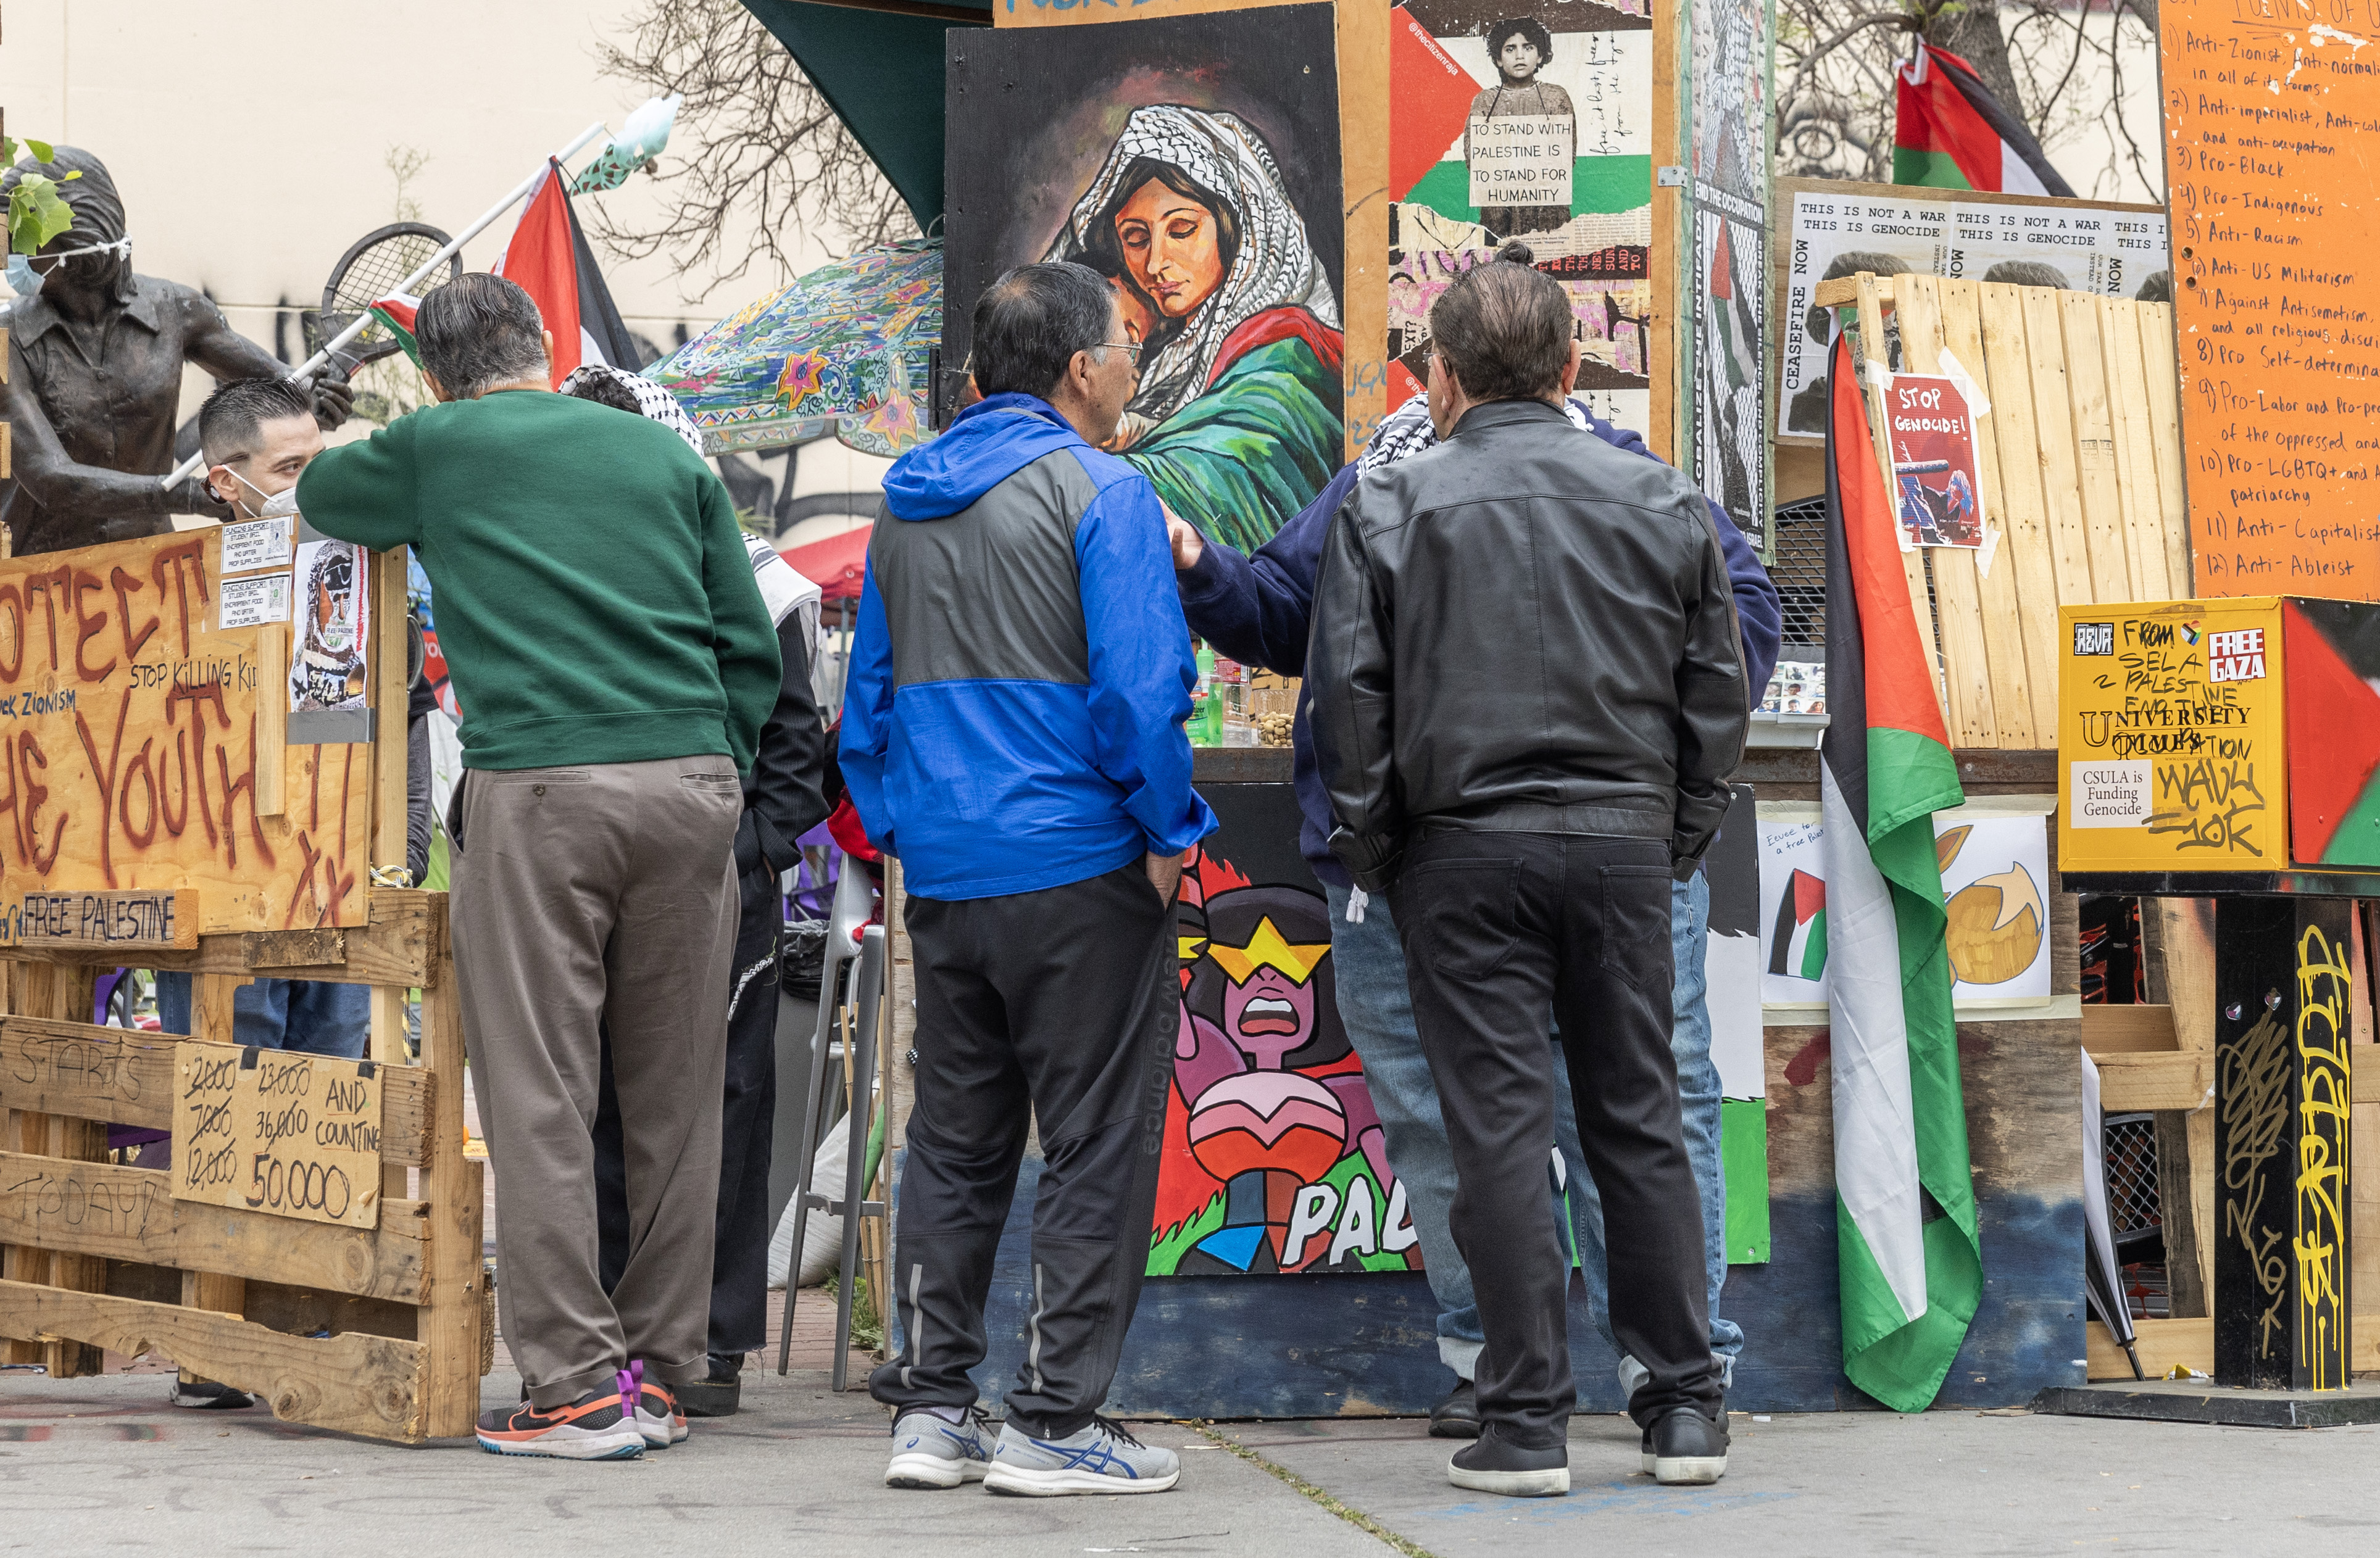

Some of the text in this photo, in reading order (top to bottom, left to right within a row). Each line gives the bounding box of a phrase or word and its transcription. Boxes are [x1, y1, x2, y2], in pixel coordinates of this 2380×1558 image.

[1408, 22, 1458, 76] @thecitizenraja
[2193, 68, 2208, 80] in
[2218, 69, 2236, 85] all
[2244, 72, 2258, 85] of
[2171, 88, 2188, 114] 2)
[1472, 123, 1571, 135] TO STAND WITH
[2203, 130, 2227, 144] and
[1472, 144, 1560, 160] PALESTINE IS
[2176, 146, 2192, 171] 3)
[1473, 168, 1567, 181] TO STAND FOR
[1488, 188, 1559, 202] HUMANITY
[1696, 181, 1763, 225] END THE OCCUPATION
[2179, 181, 2196, 210] 4)
[1800, 204, 1946, 222] THIS IS NOT A WAR
[1957, 213, 2101, 231] THIS IS NOT A WAR
[1804, 220, 1941, 238] THIS IS GENOCIDE
[1960, 230, 2095, 246] THIS IS GENOCIDE
[2115, 223, 2148, 233] THIS
[2186, 215, 2200, 244] 5)
[2118, 238, 2150, 249] THIS
[1619, 249, 1629, 271] AND
[1631, 254, 1641, 270] TO
[1696, 209, 1704, 319] INTIFADA
[2108, 257, 2122, 293] NOW
[2282, 266, 2355, 288] Militarism
[1786, 239, 1808, 390] CEASEFIRE NOW
[2216, 288, 2270, 315] Against
[1696, 321, 1704, 372] THE
[2212, 320, 2234, 334] and
[2245, 323, 2263, 335] all
[2273, 323, 2330, 347] religious
[2197, 337, 2213, 365] 8)
[2220, 345, 2244, 364] Pro
[1899, 387, 1942, 410] STOP
[2199, 378, 2216, 413] 9)
[2307, 400, 2329, 414] and
[1894, 415, 1968, 441] GENOCIDE!
[2222, 423, 2380, 452] of the oppressed and
[2200, 449, 2222, 478] 10)
[2347, 468, 2367, 481] and
[2231, 485, 2310, 508] patriarchy
[225, 524, 246, 535] FUNDING
[2207, 511, 2227, 541] 11)
[1745, 532, 1764, 549] ISRAEL
[241, 557, 262, 565] SUPPLIES
[2207, 553, 2228, 577] 12)
[239, 616, 260, 624] SUPPLIES
[2124, 619, 2175, 648] FROM
[2209, 628, 2263, 657] FREE
[130, 663, 167, 690] STOP
[2210, 654, 2266, 682] GAZA
[2125, 670, 2238, 708] PALESTINE
[2125, 696, 2224, 724] END THE
[2079, 707, 2252, 748] UNIVERSITY
[2113, 734, 2200, 760] TIMES
[75, 679, 277, 890] YOUTH
[2083, 769, 2143, 784] CSULA is
[2087, 787, 2139, 803] Funding
[2084, 803, 2142, 816] Genocide
[1766, 829, 1797, 847] Eevee
[1786, 838, 1805, 849] free
[25, 896, 72, 937] FREE
[325, 1079, 366, 1112] AND
[1142, 1013, 1178, 1156] balance
[315, 1117, 381, 1153] COUNTING
[246, 1151, 351, 1219] 50,000
[7, 1174, 158, 1246] TODAY!
